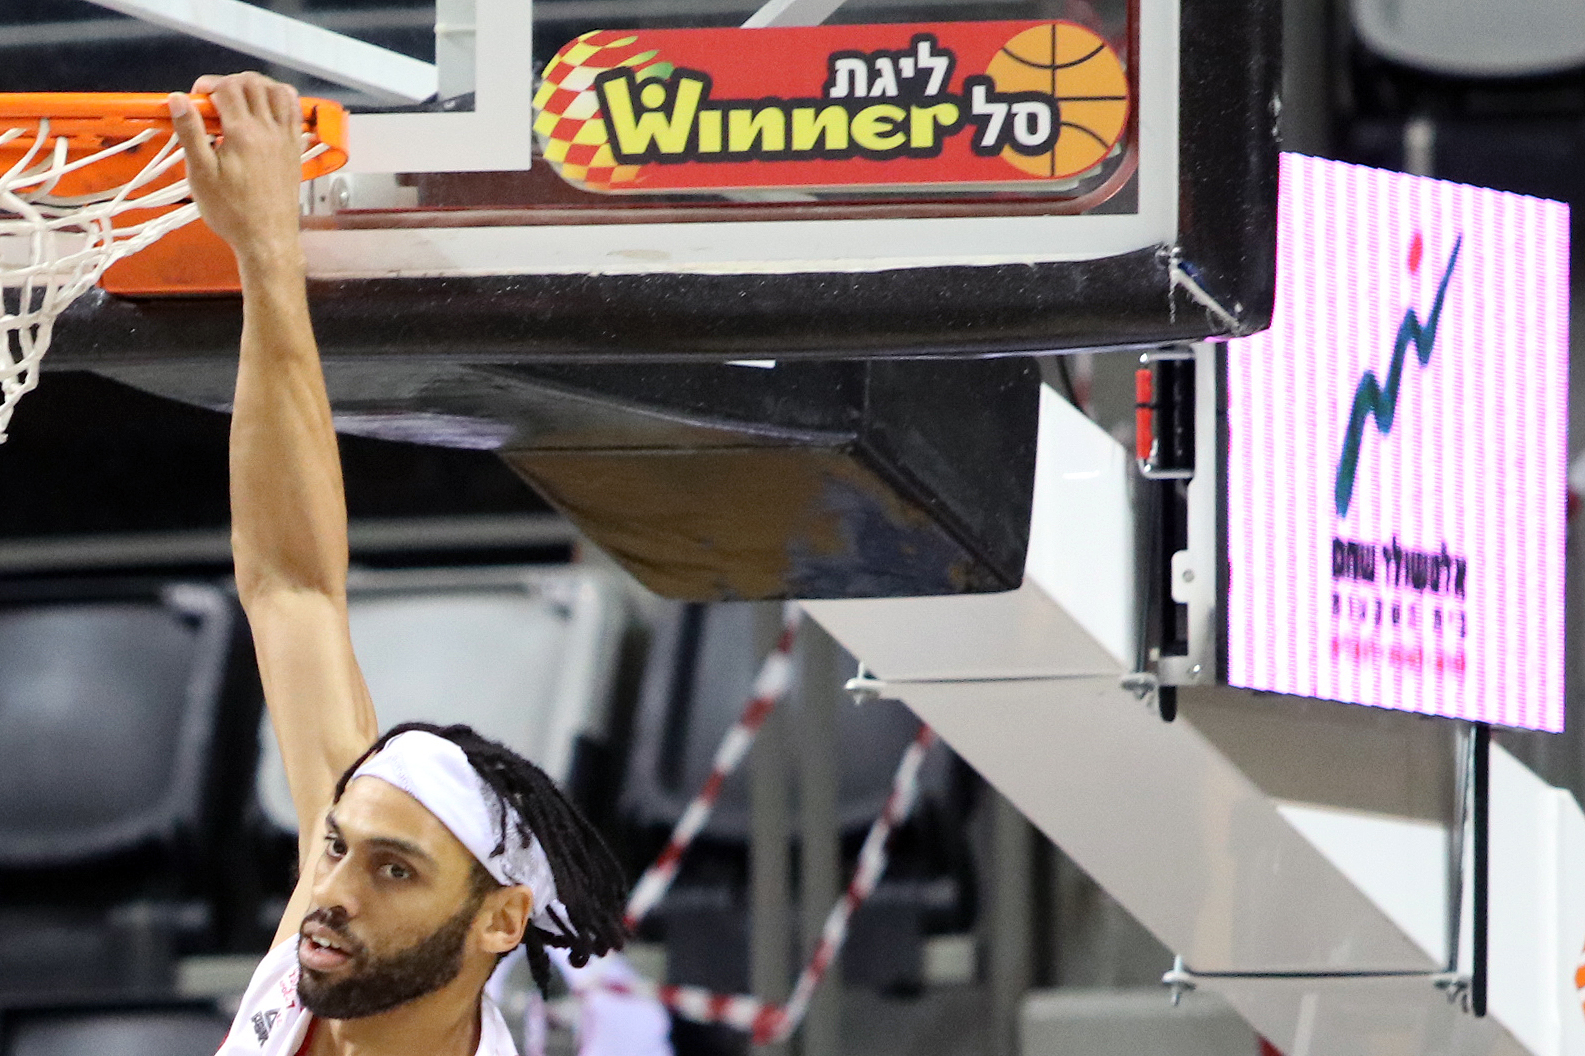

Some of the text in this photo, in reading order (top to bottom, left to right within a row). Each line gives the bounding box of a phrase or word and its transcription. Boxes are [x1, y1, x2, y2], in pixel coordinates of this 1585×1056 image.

[830, 41, 949, 98] ליגת
[602, 77, 1052, 155] Winner סל
